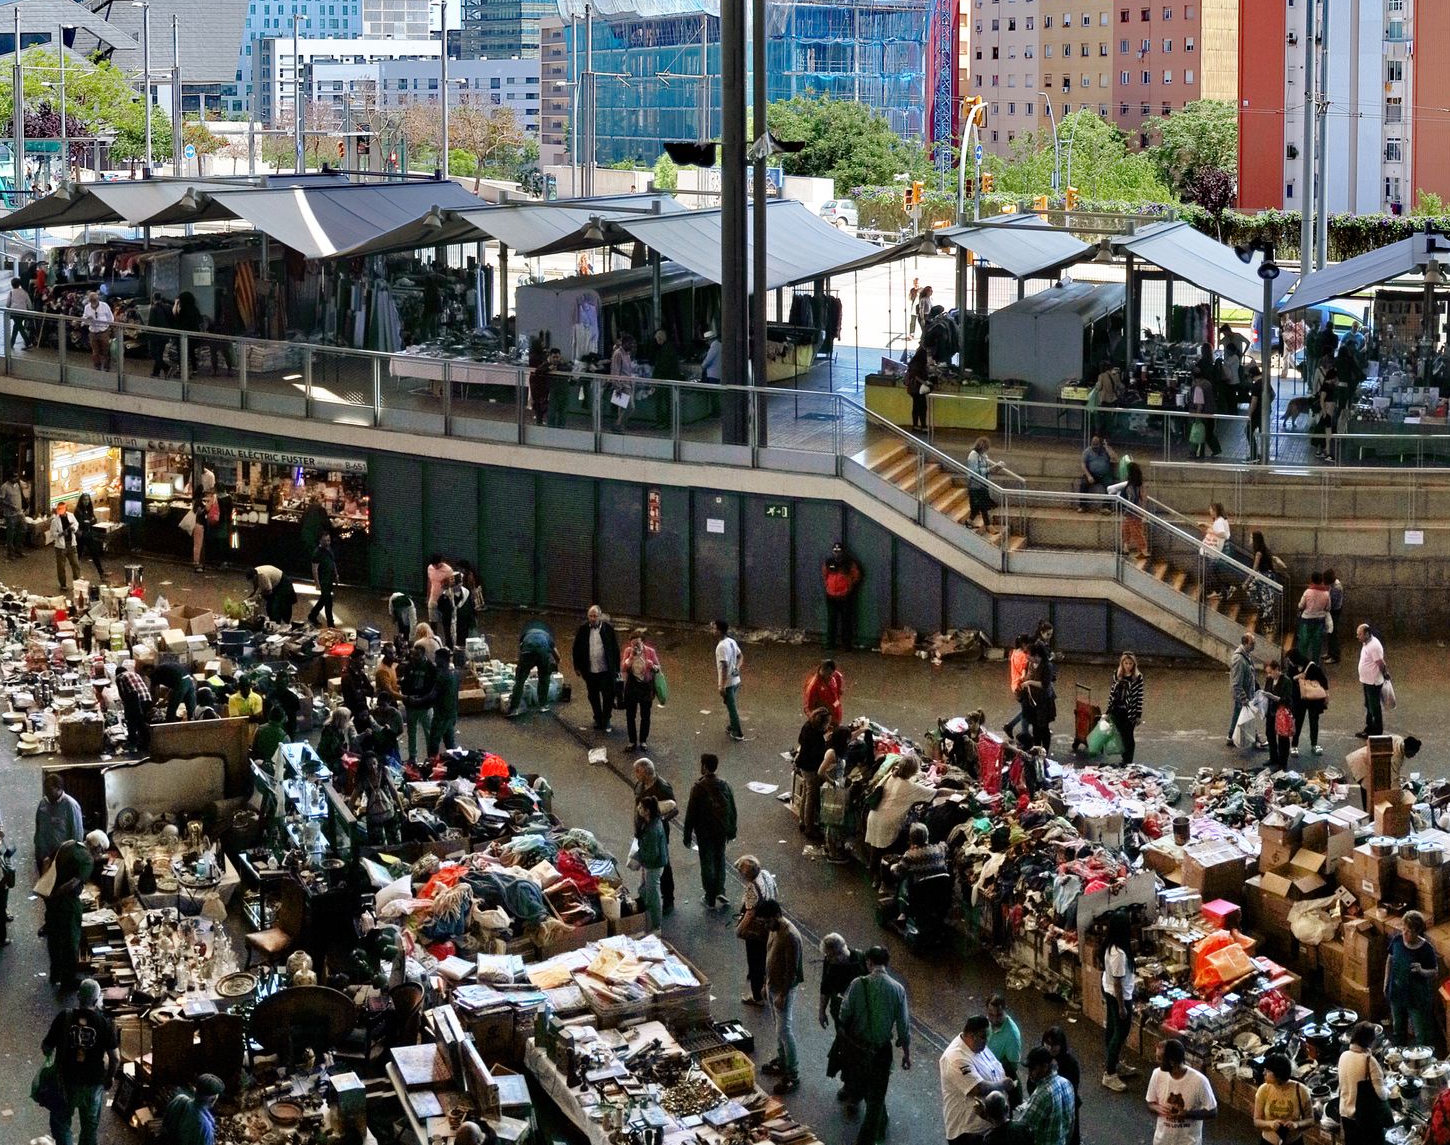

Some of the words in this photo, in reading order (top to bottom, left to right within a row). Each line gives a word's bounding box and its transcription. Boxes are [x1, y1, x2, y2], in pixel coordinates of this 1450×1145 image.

[196, 445, 236, 457] MATERIAL
[238, 450, 279, 462] ELECTRIC
[281, 455, 316, 466] FUSTER
[345, 461, 367, 471] B-651
